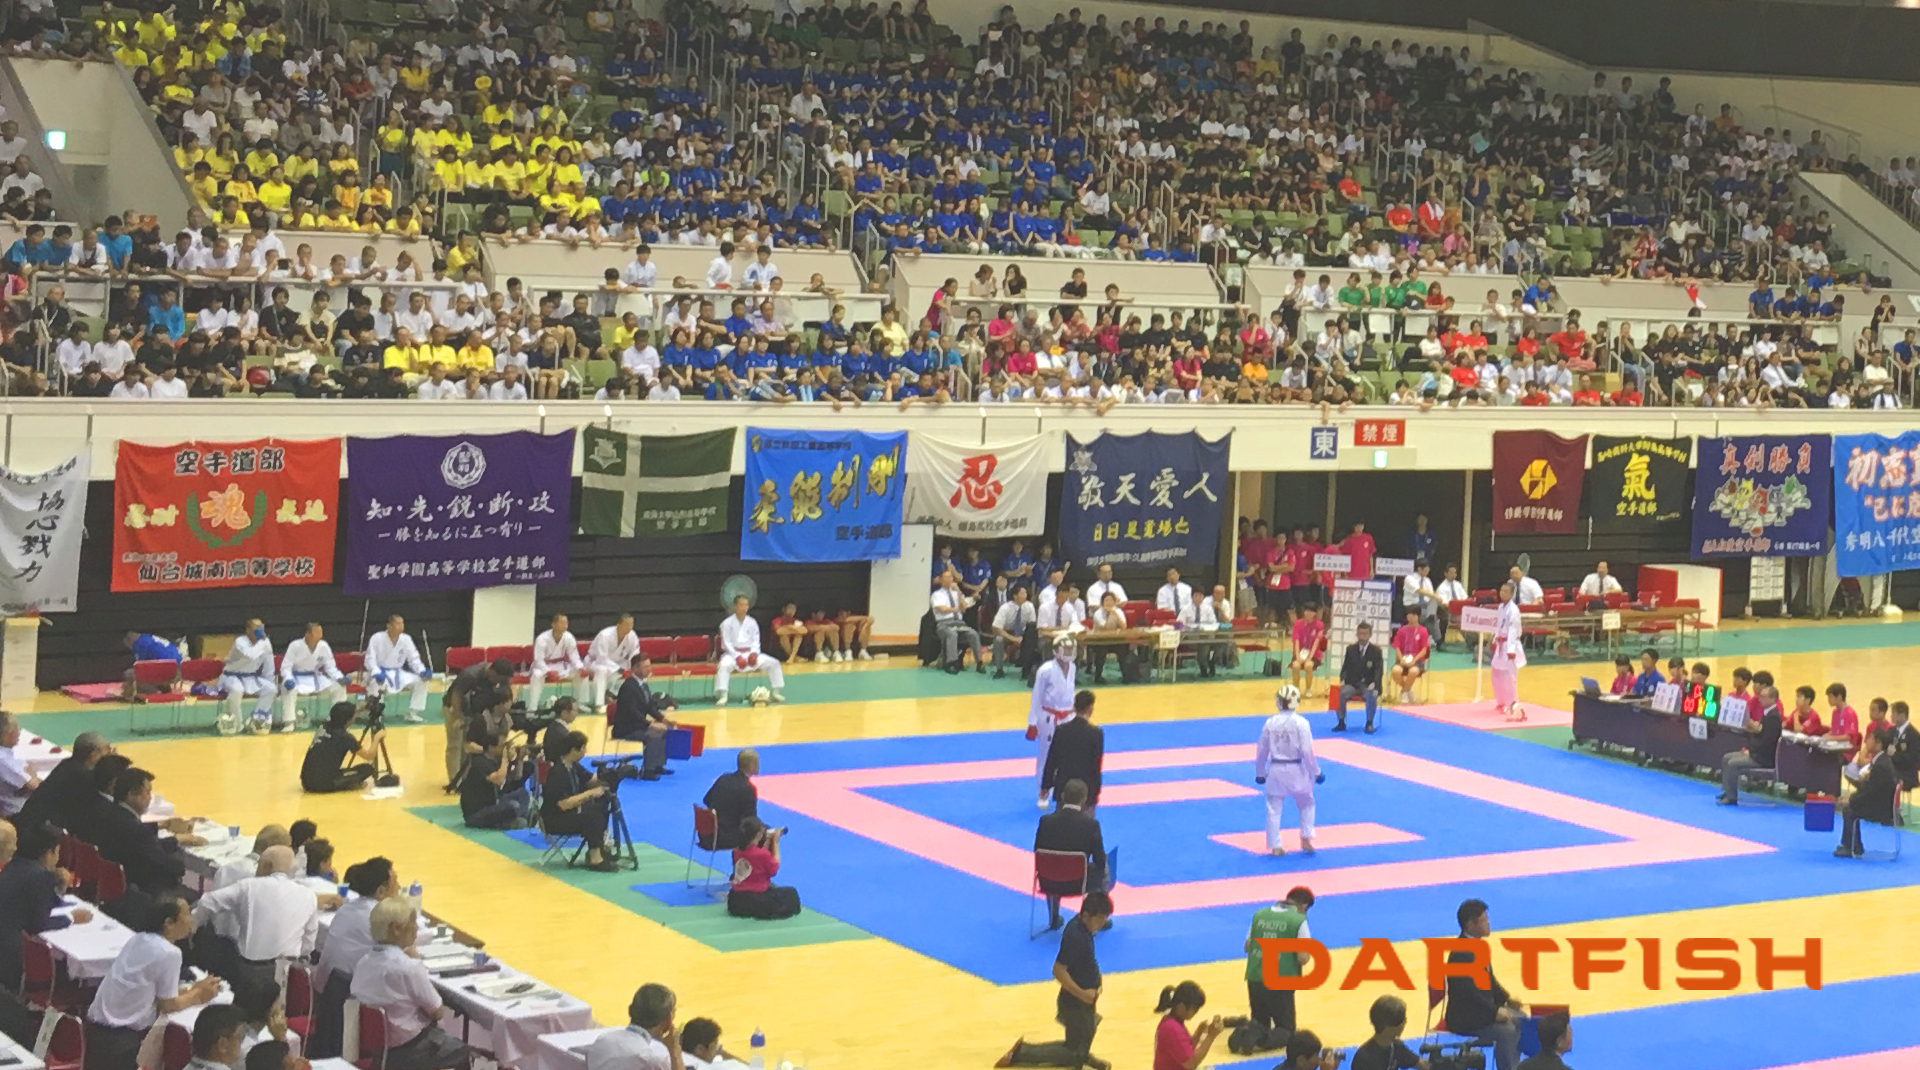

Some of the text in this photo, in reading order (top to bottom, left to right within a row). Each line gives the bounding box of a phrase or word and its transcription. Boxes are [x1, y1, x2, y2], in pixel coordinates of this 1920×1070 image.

[1312, 429, 1336, 458] 東
[1362, 423, 1398, 443] 禁煙
[175, 447, 285, 475] 空手道部
[949, 454, 1003, 510] 忍
[1078, 466, 1218, 510] 敬天愛人
[1622, 452, 1656, 501] 氣
[138, 556, 316, 583] 仙台城南高等学校
